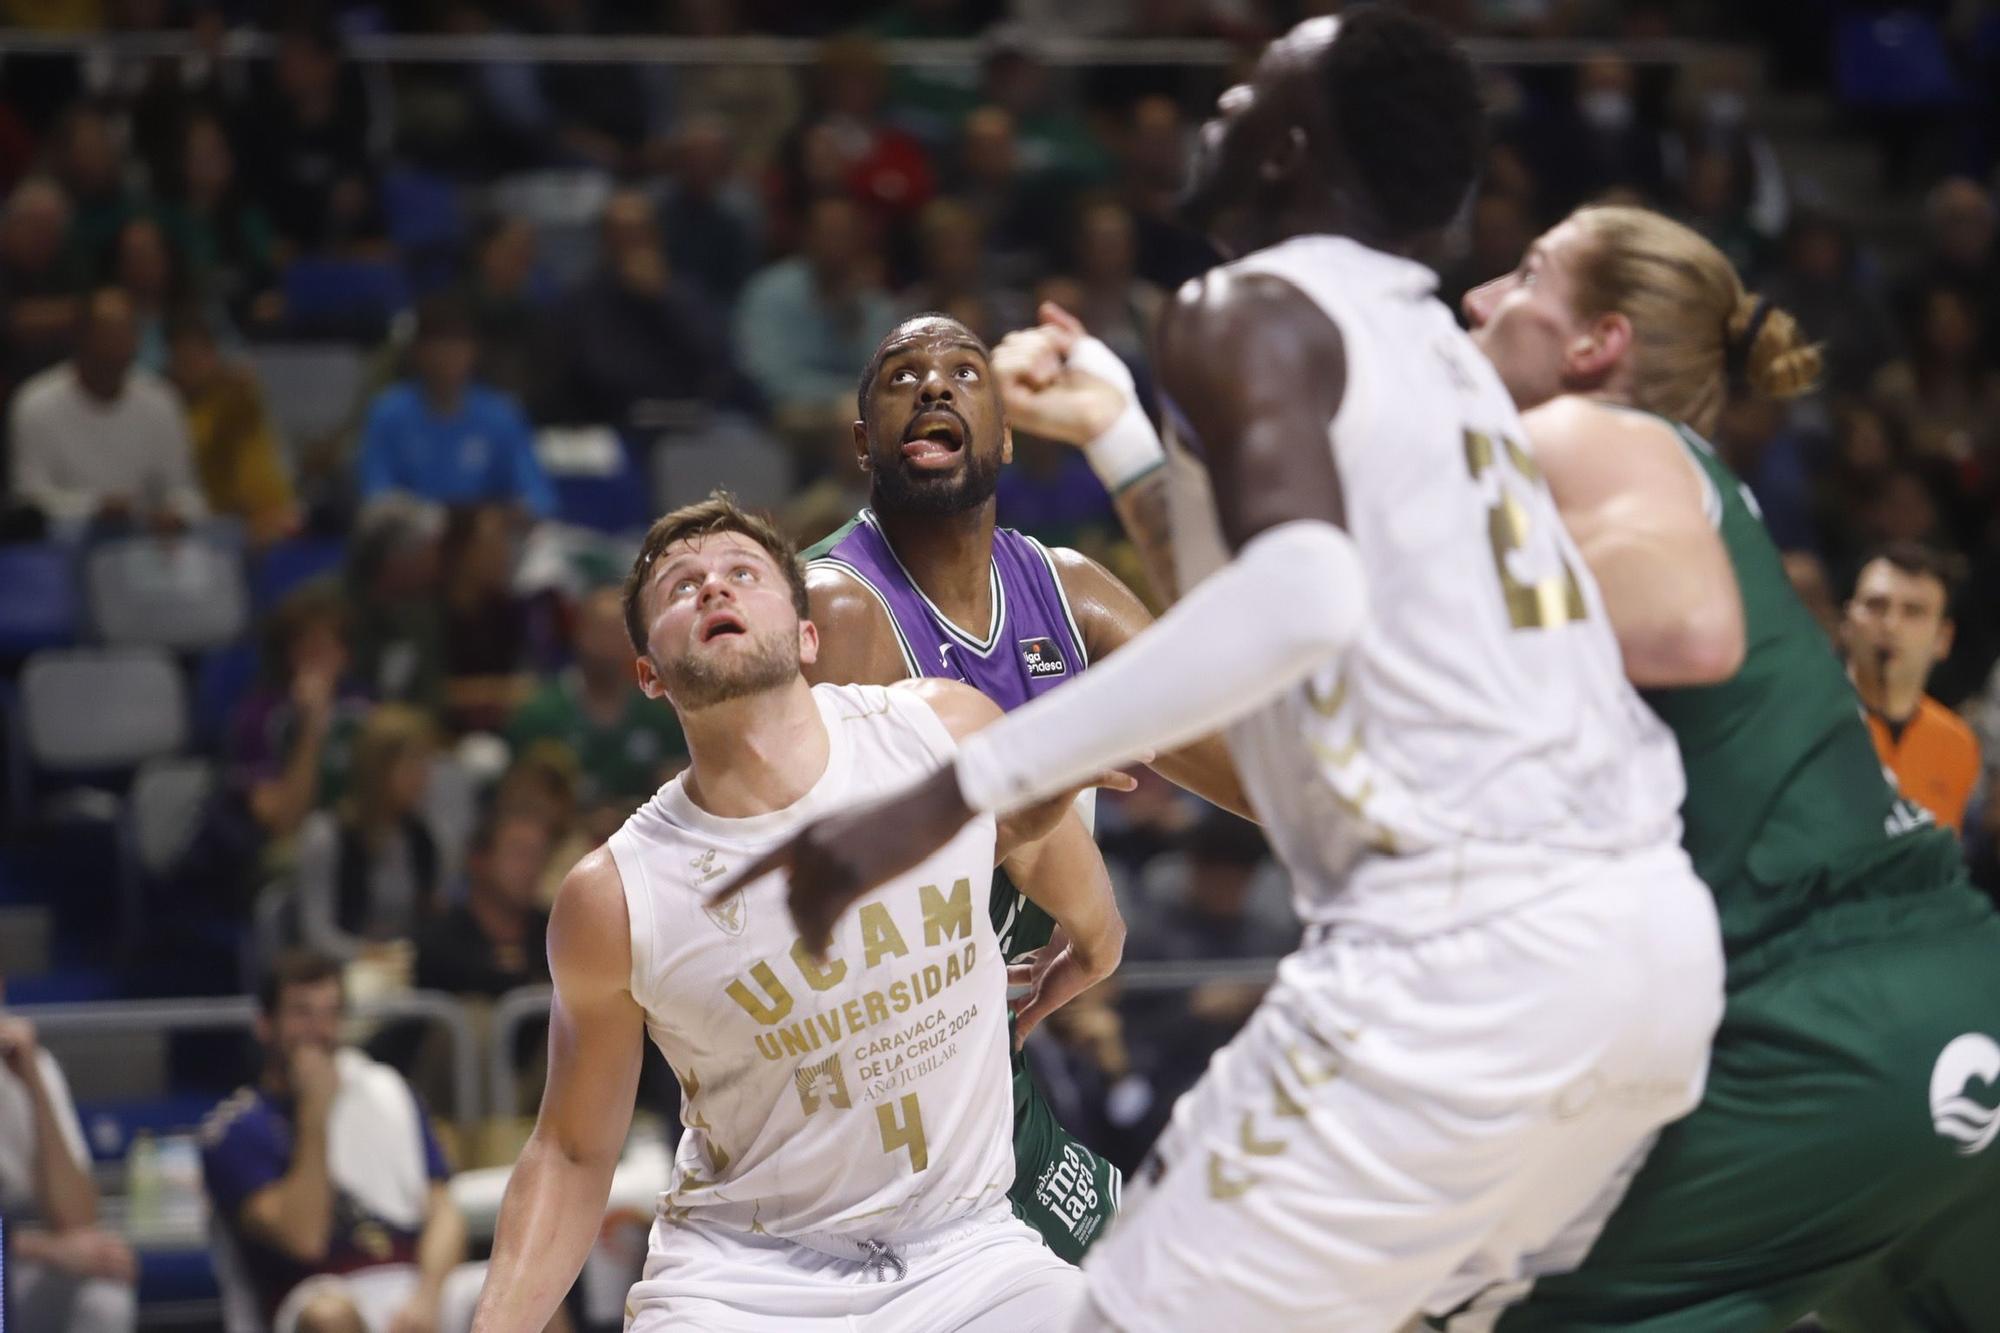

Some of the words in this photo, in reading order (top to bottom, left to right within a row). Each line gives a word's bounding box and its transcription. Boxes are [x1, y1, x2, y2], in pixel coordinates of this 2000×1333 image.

[1027, 661, 1063, 673] endesa
[724, 876, 973, 1026] UCAM
[754, 942, 976, 1061] UNIVERSIDAD
[855, 1009, 946, 1061] CARAVACA
[859, 1061, 883, 1081] DE
[885, 1054, 904, 1073] LA
[906, 1029, 947, 1059] CRUZ
[948, 1004, 978, 1036] 2024
[864, 1076, 896, 1102] AÑO
[900, 1043, 958, 1086] JUBILAR
[875, 1092, 929, 1174] 4
[1036, 1160, 1055, 1197] sabor
[1038, 1192, 1052, 1206] a
